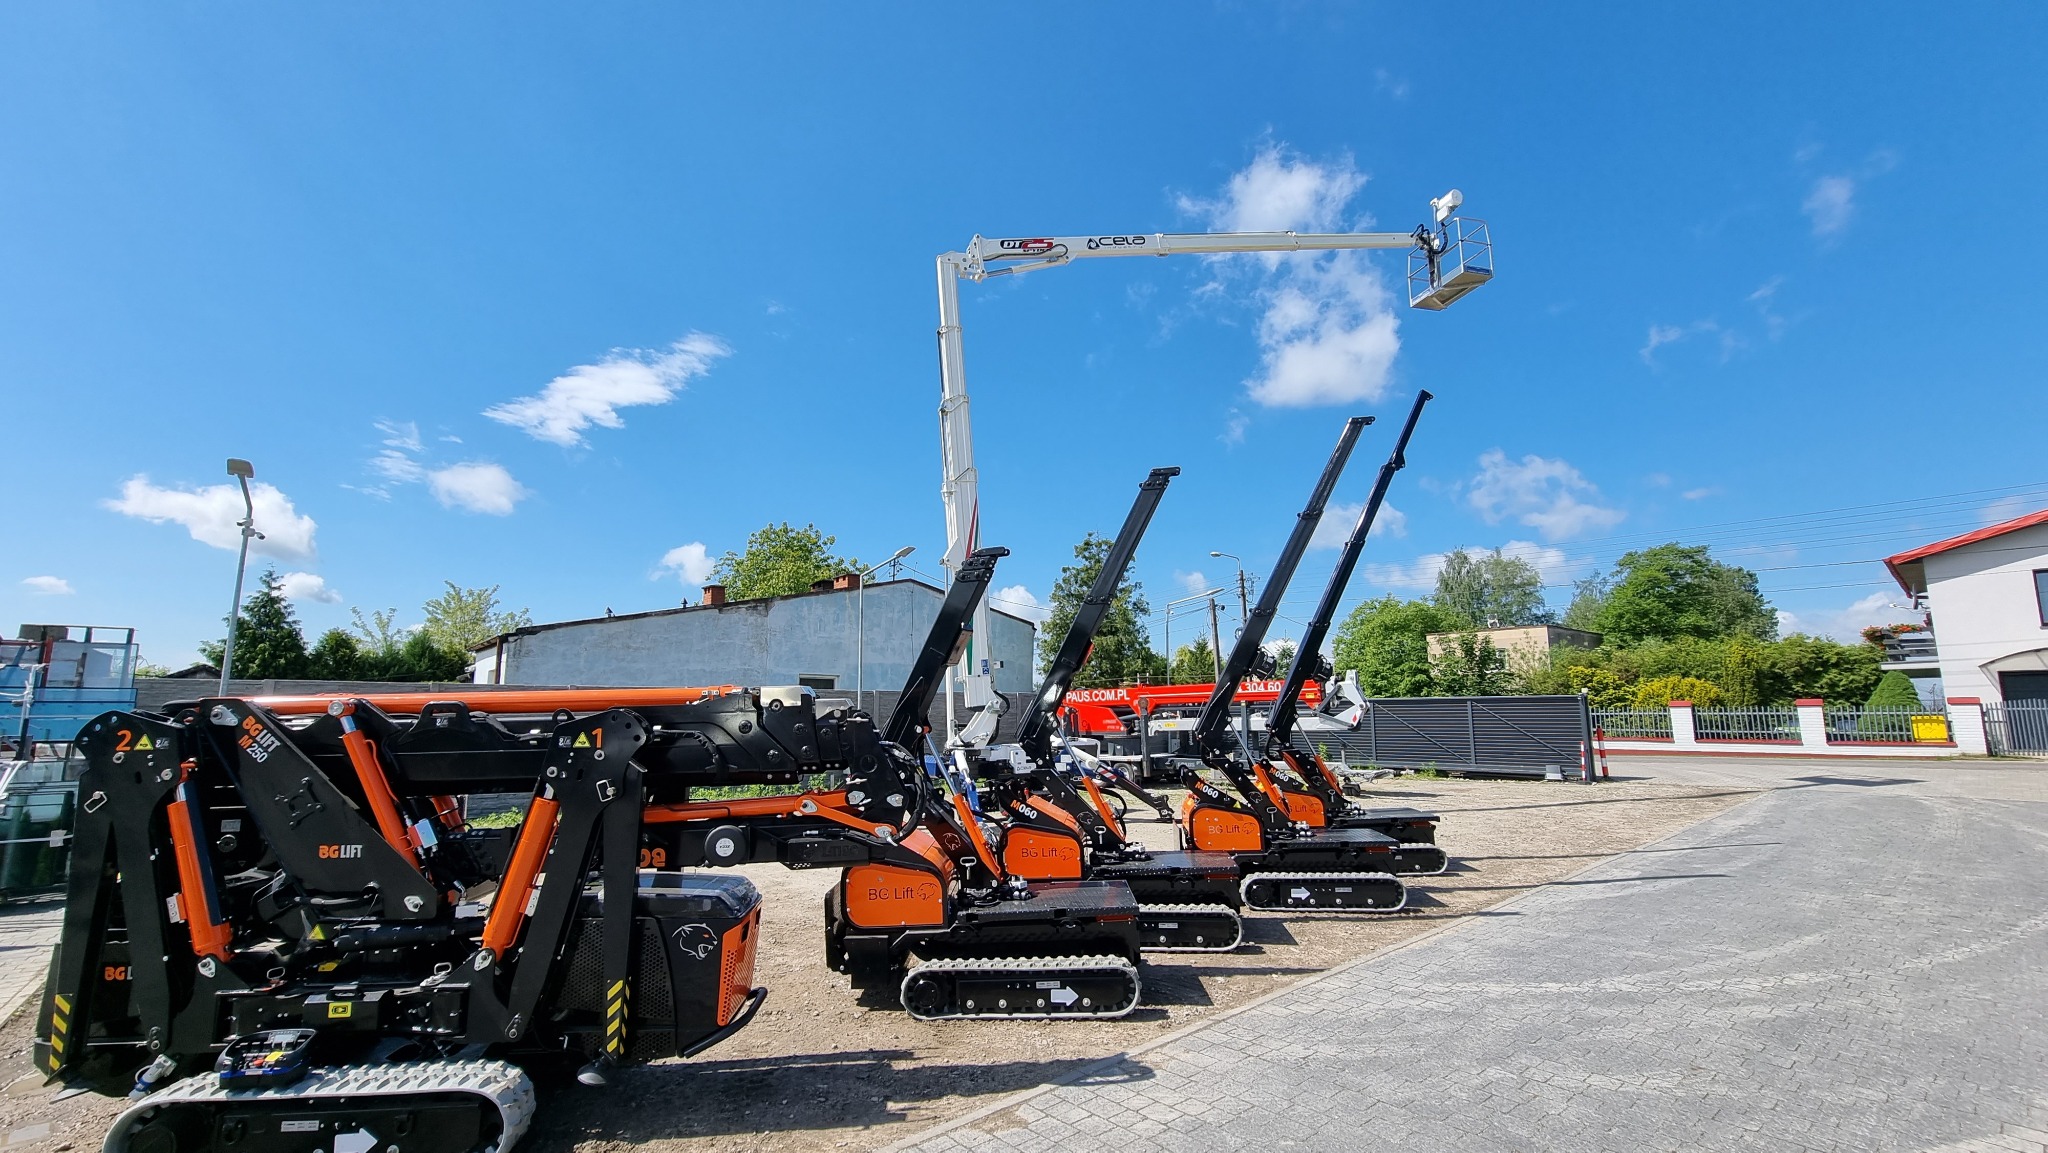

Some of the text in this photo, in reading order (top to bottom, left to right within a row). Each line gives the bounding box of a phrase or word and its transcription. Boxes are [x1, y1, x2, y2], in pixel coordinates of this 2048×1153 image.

[1066, 690, 1130, 702] PAUS.COM.PL
[116, 730, 132, 751] 2
[592, 728, 602, 748] 1
[238, 735, 268, 763] M250
[1269, 767, 1289, 782] M060
[1195, 781, 1219, 799] M060
[1010, 800, 1037, 819] M060
[1226, 824, 1240, 834] Lift
[1021, 847, 1057, 858] BG Lift
[868, 886, 915, 900] BG Lift
